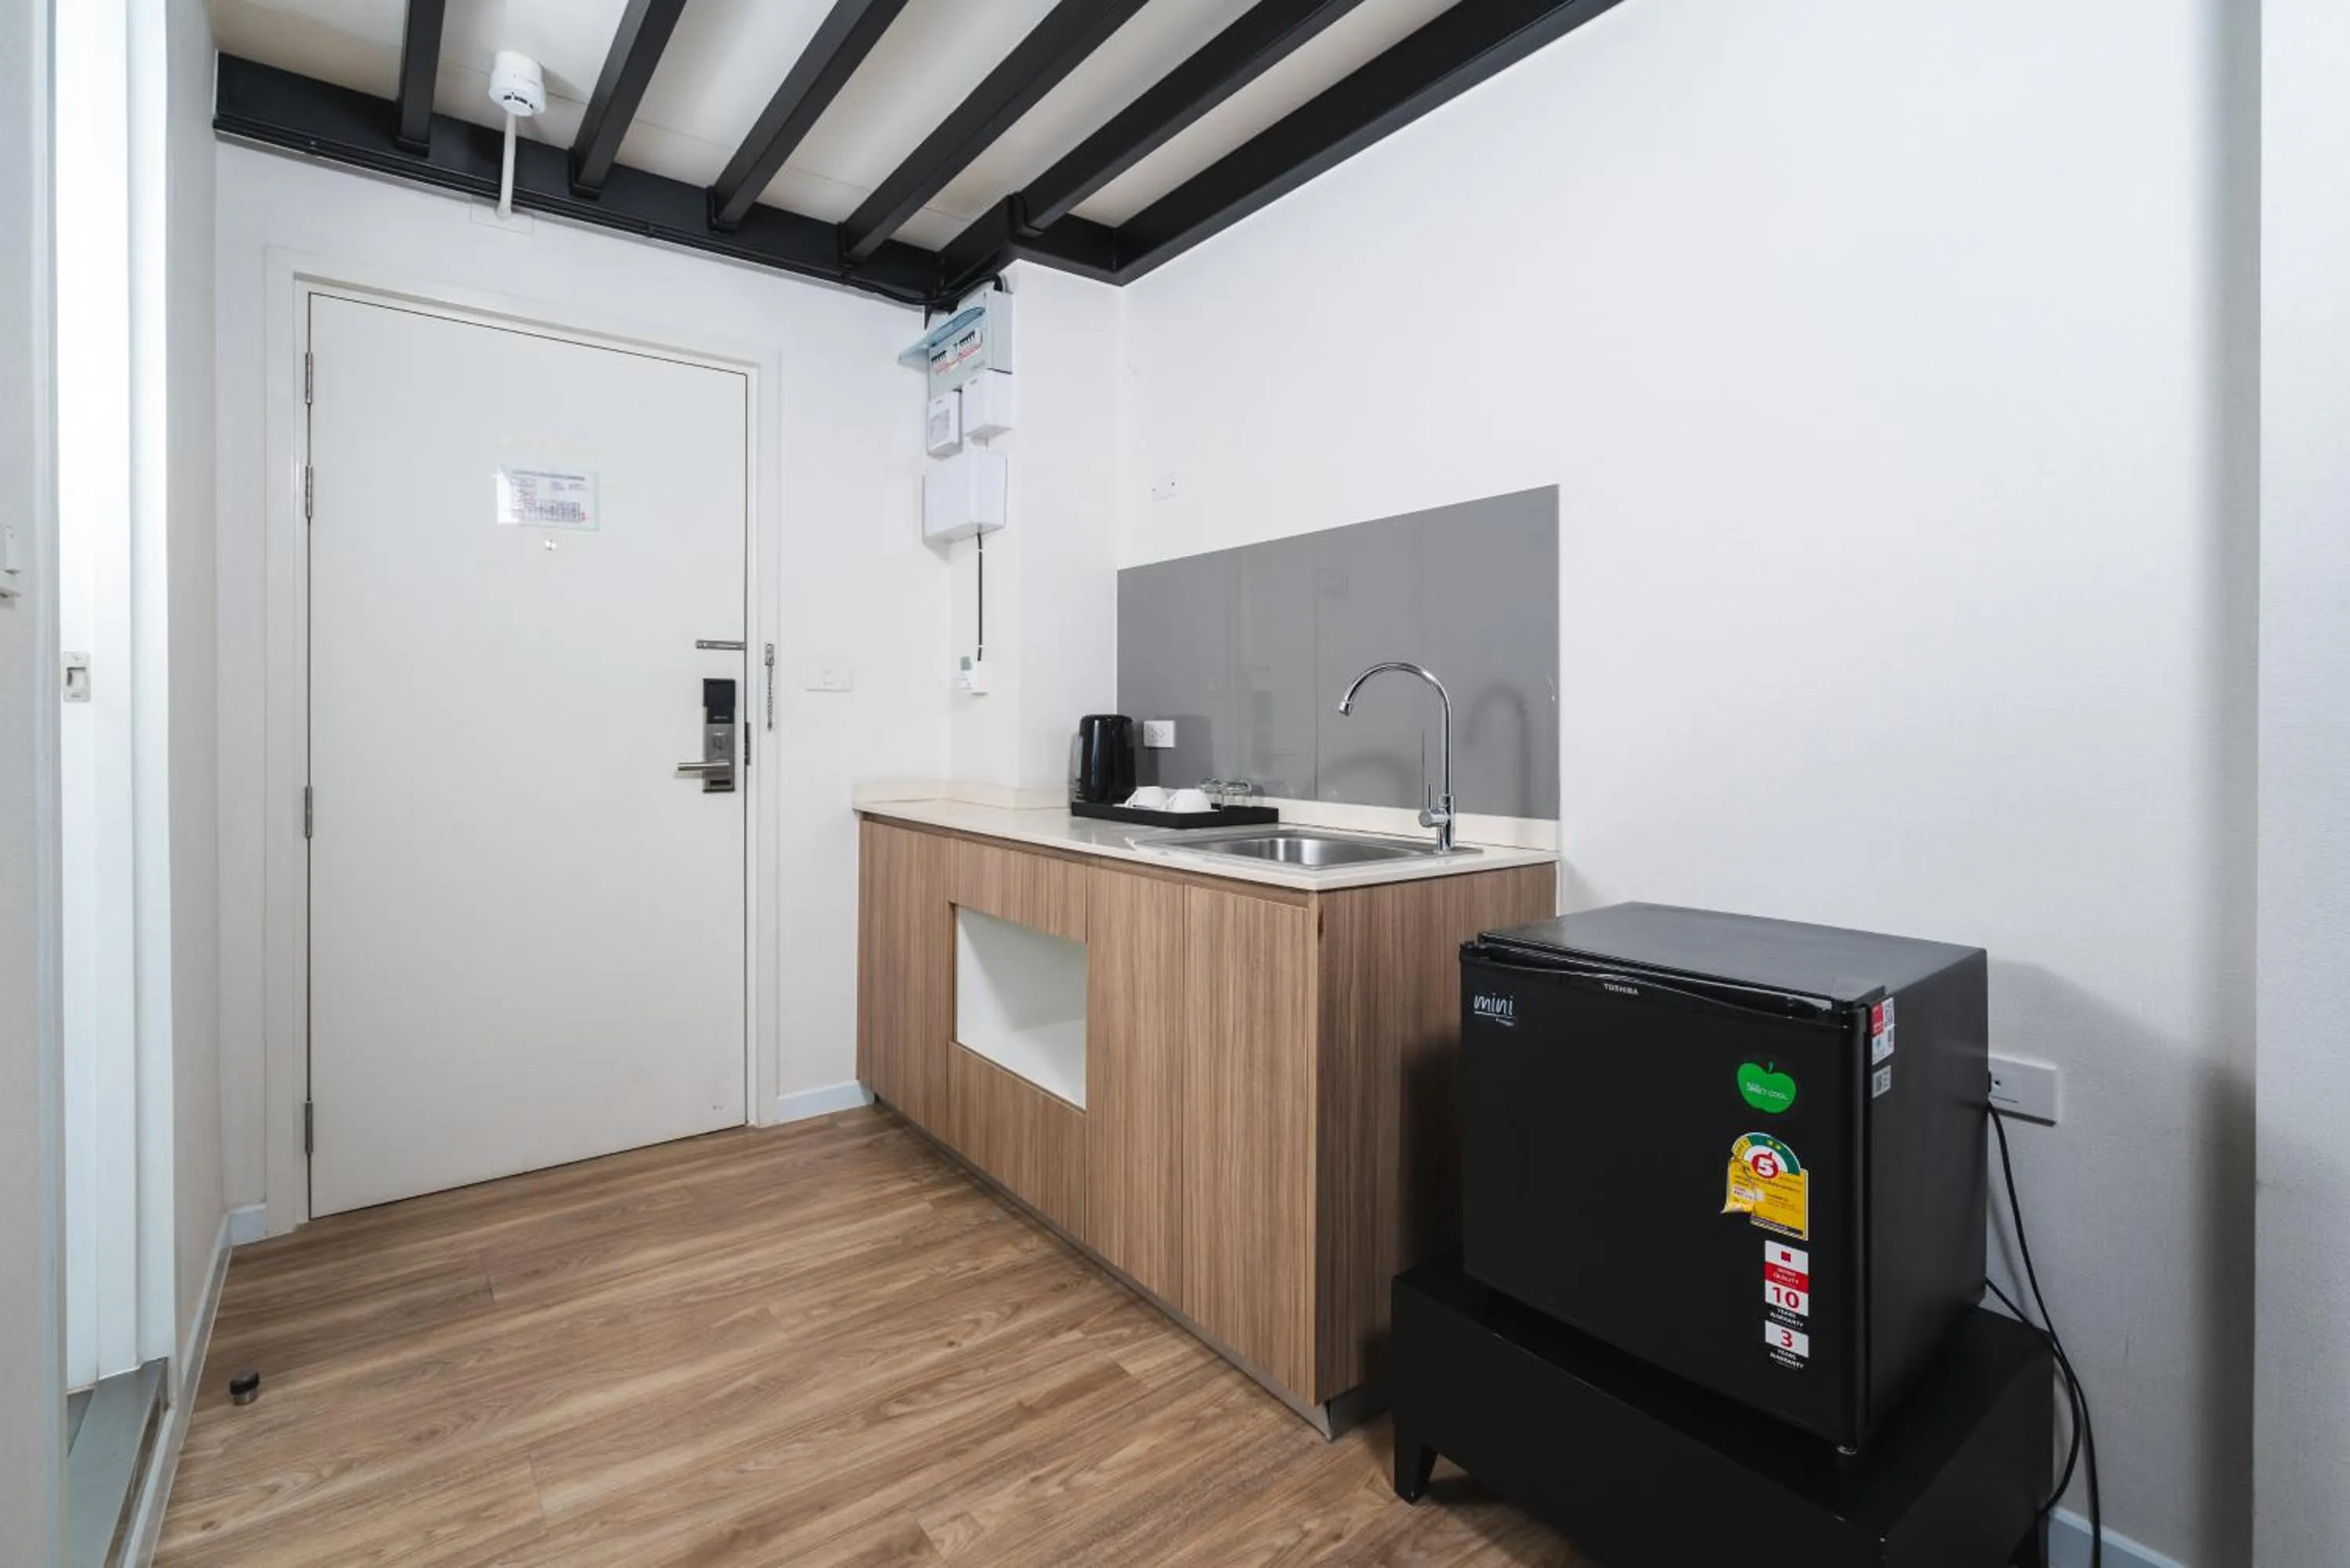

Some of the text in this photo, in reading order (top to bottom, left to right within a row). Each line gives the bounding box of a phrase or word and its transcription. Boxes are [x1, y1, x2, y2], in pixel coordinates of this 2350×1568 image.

[1603, 983, 1640, 995] TOSHIBA
[1473, 992, 1513, 1016] mini
[1756, 1156, 1775, 1177] 5
[1772, 1287, 1800, 1309] 10
[1770, 1312, 1804, 1328] WARRANTY
[1781, 1329, 1793, 1348] 3
[1770, 1352, 1804, 1369] WARRANTY
